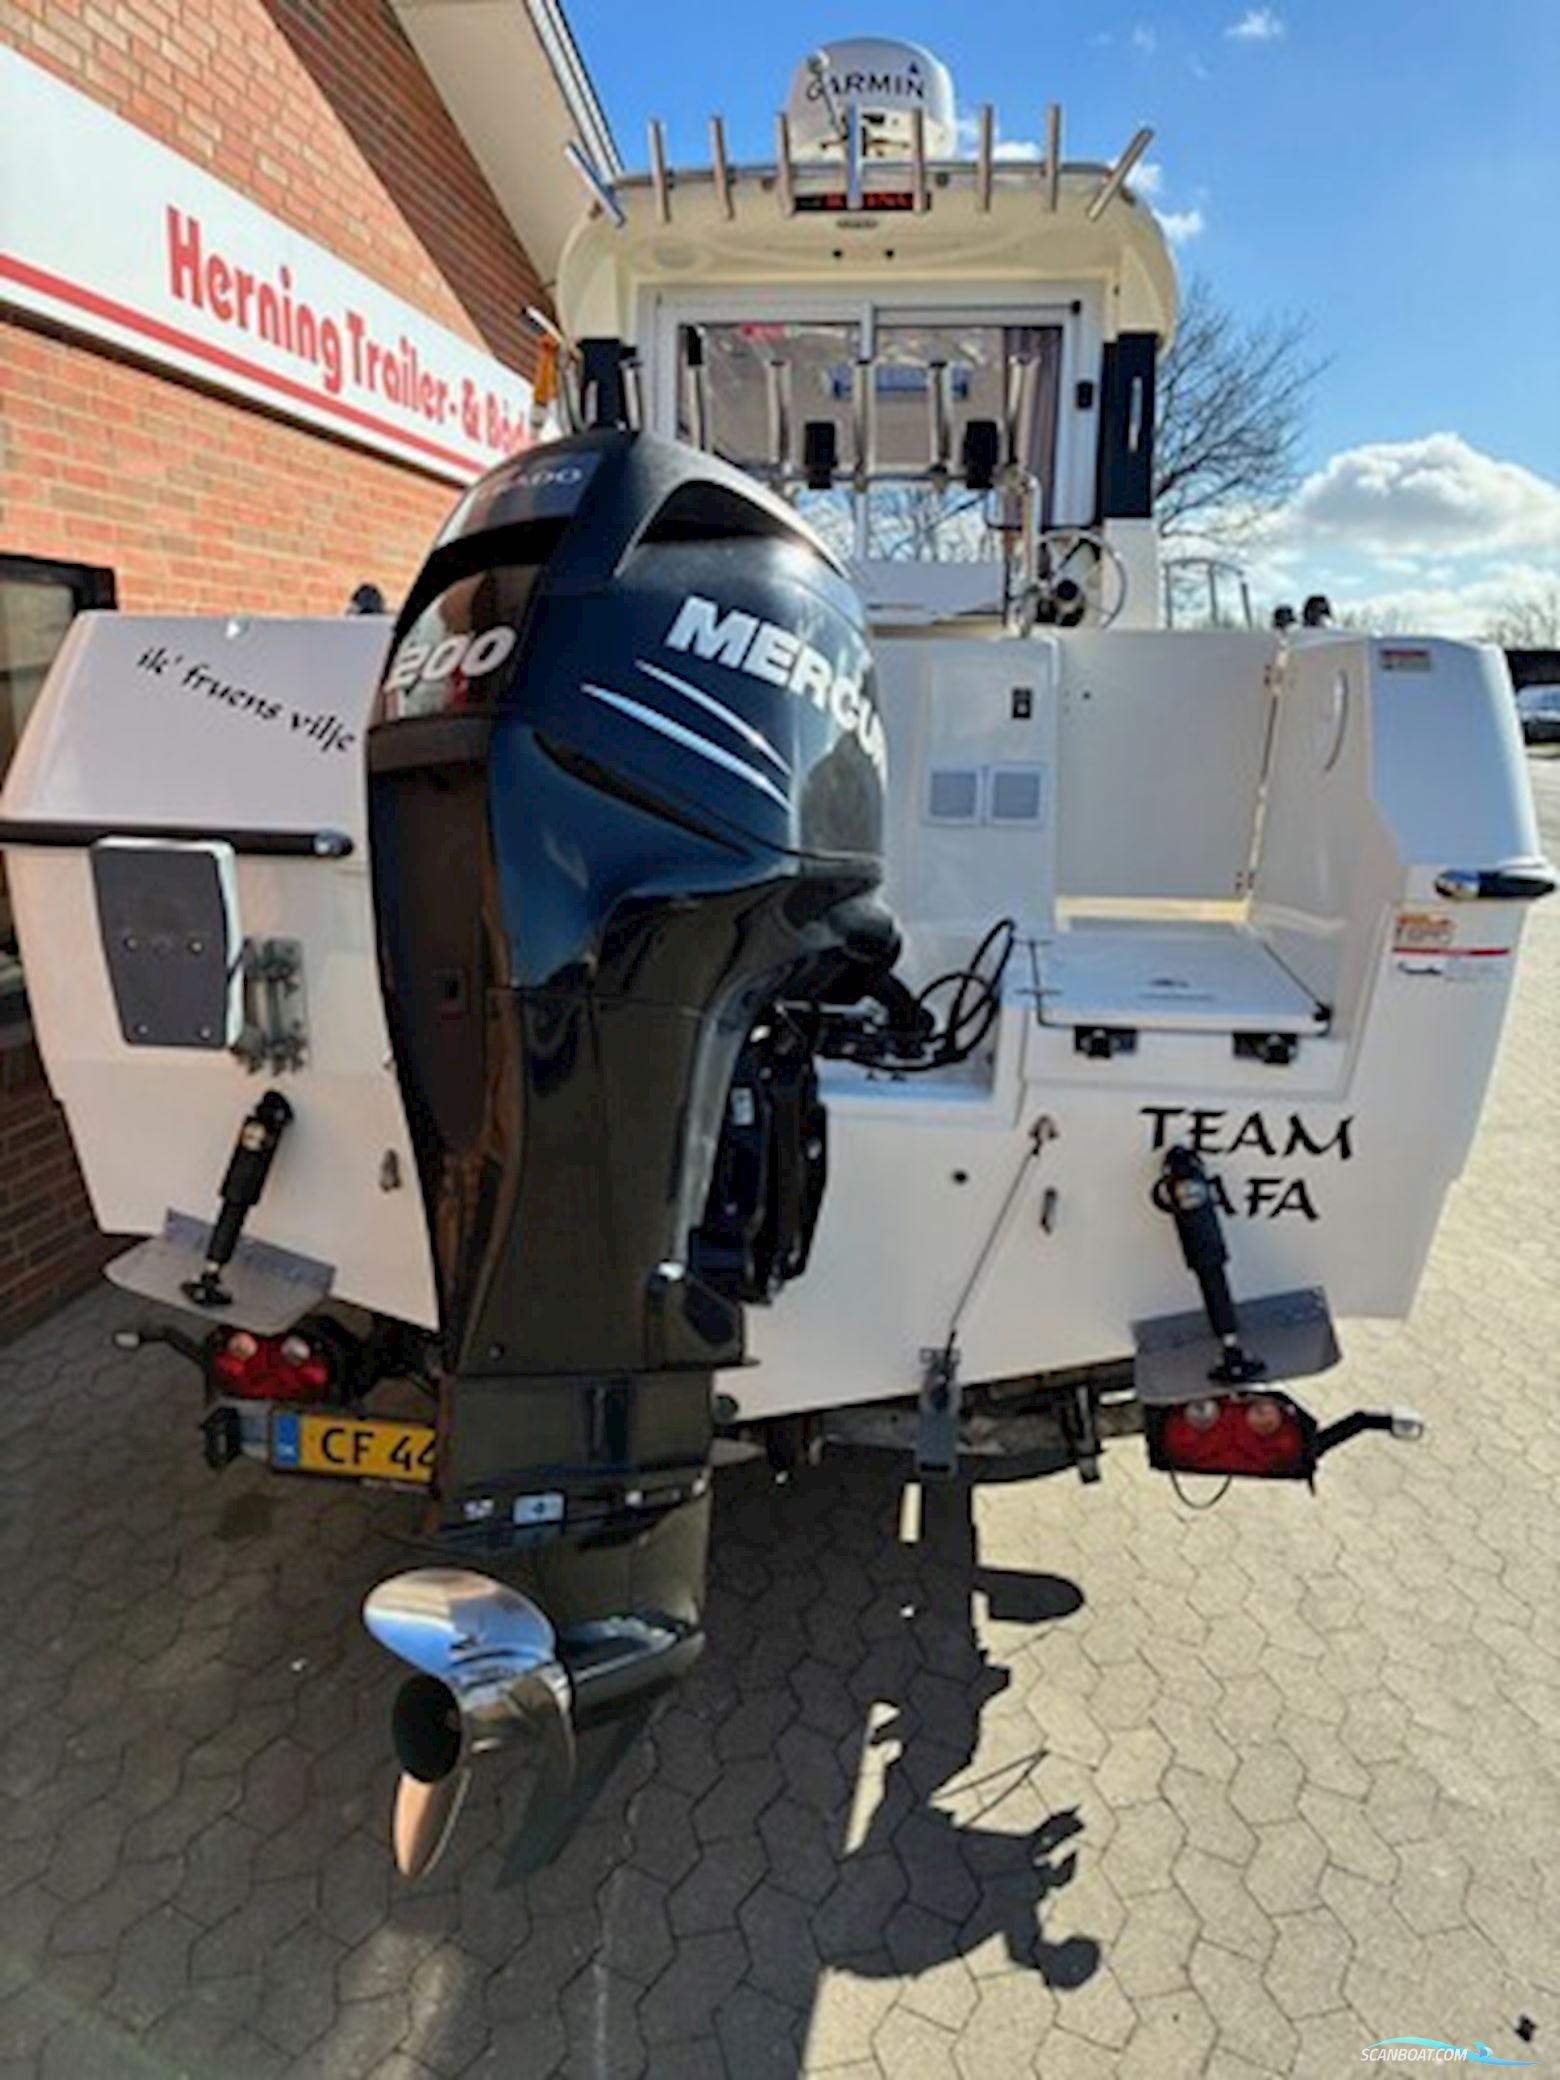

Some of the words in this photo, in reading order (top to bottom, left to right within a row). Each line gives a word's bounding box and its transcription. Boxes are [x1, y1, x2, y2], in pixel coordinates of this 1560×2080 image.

[806, 72, 924, 101] GARMIN
[166, 204, 342, 394] Herning
[347, 310, 457, 424] Trailer-
[462, 377, 482, 442] &
[384, 625, 517, 692] 200
[289, 712, 356, 753] vilje
[1139, 1107, 1354, 1160] TEAM
[321, 1428, 374, 1465] CF
